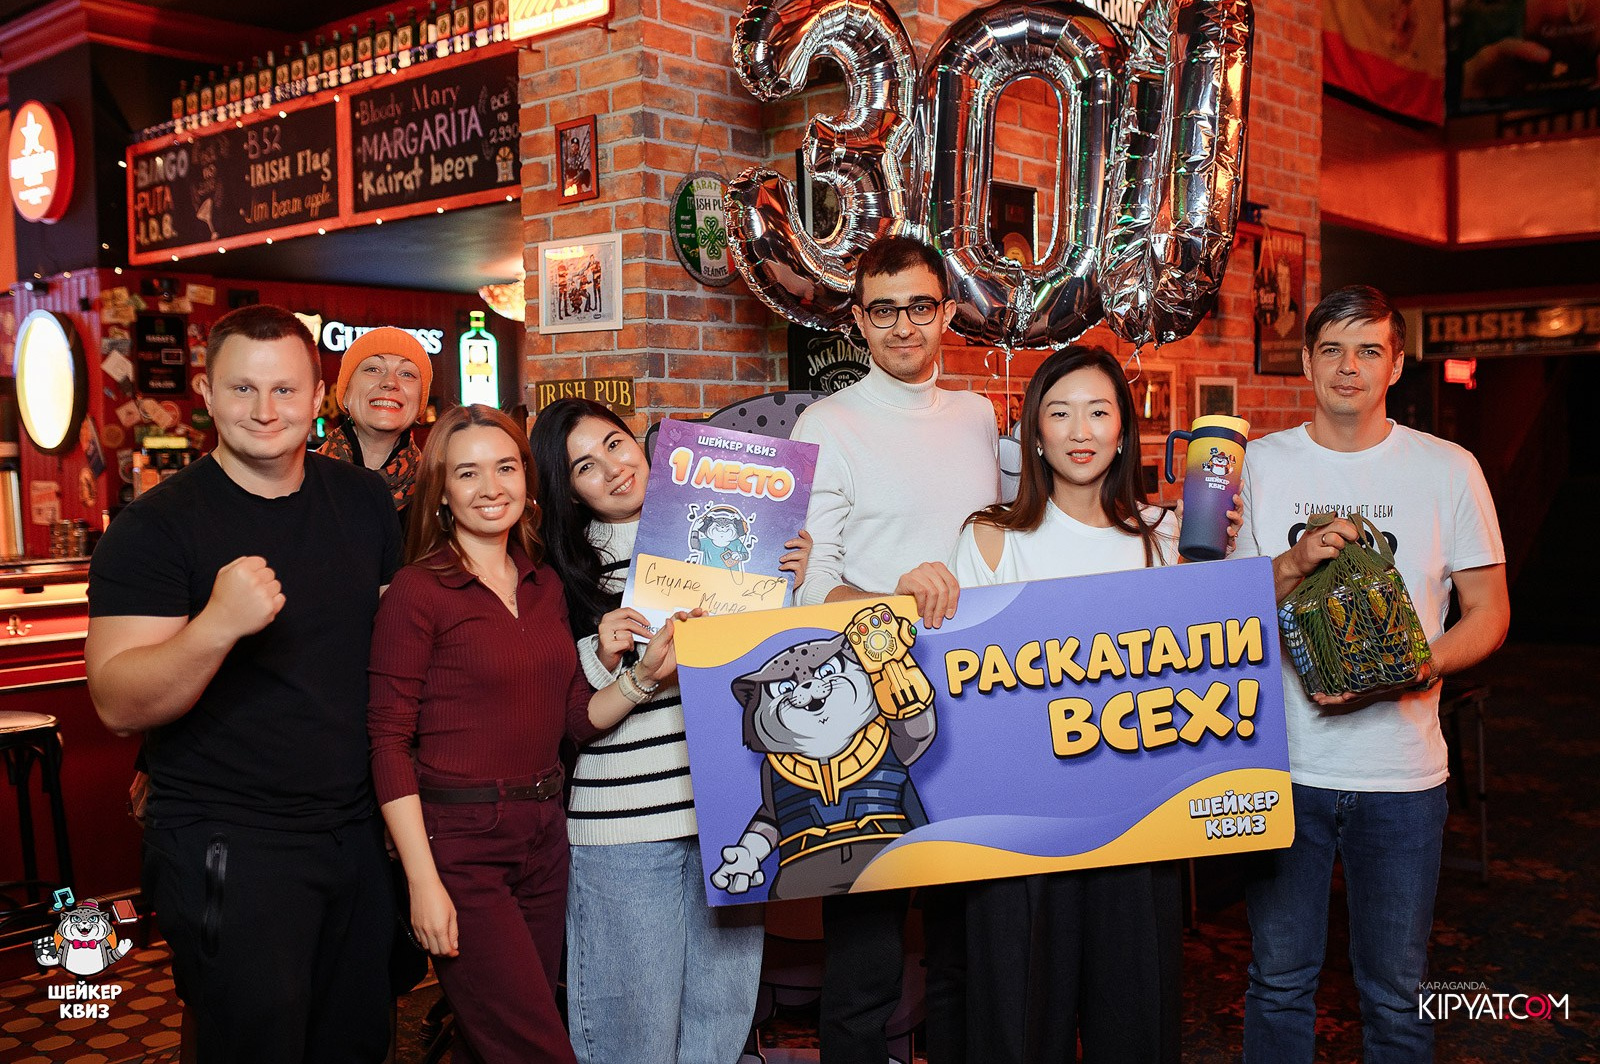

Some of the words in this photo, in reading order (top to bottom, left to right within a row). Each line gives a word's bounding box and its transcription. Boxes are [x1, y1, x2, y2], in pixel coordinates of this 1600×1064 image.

[411, 84, 460, 112] Mary
[361, 105, 483, 163] MARGARITA
[250, 155, 291, 188] IRISH
[430, 153, 479, 186] beer
[686, 196, 711, 211] IRISH
[713, 198, 724, 211] PU
[1428, 313, 1525, 342] IRISH
[807, 346, 836, 377] JACK
[539, 381, 587, 410] IRISH
[594, 380, 632, 407] PUB
[697, 435, 743, 452] ШЕЙКЕР
[745, 443, 777, 458] КВИЗ
[671, 448, 693, 483] 1
[693, 459, 794, 499] МЕСТО
[1294, 503, 1300, 515] У
[945, 617, 1264, 697] РАСКАТАЛИ
[1048, 679, 1260, 759] ВСЕХ!
[1189, 790, 1280, 819] ШЕЙКЕР
[1205, 815, 1267, 839] КВИЗ
